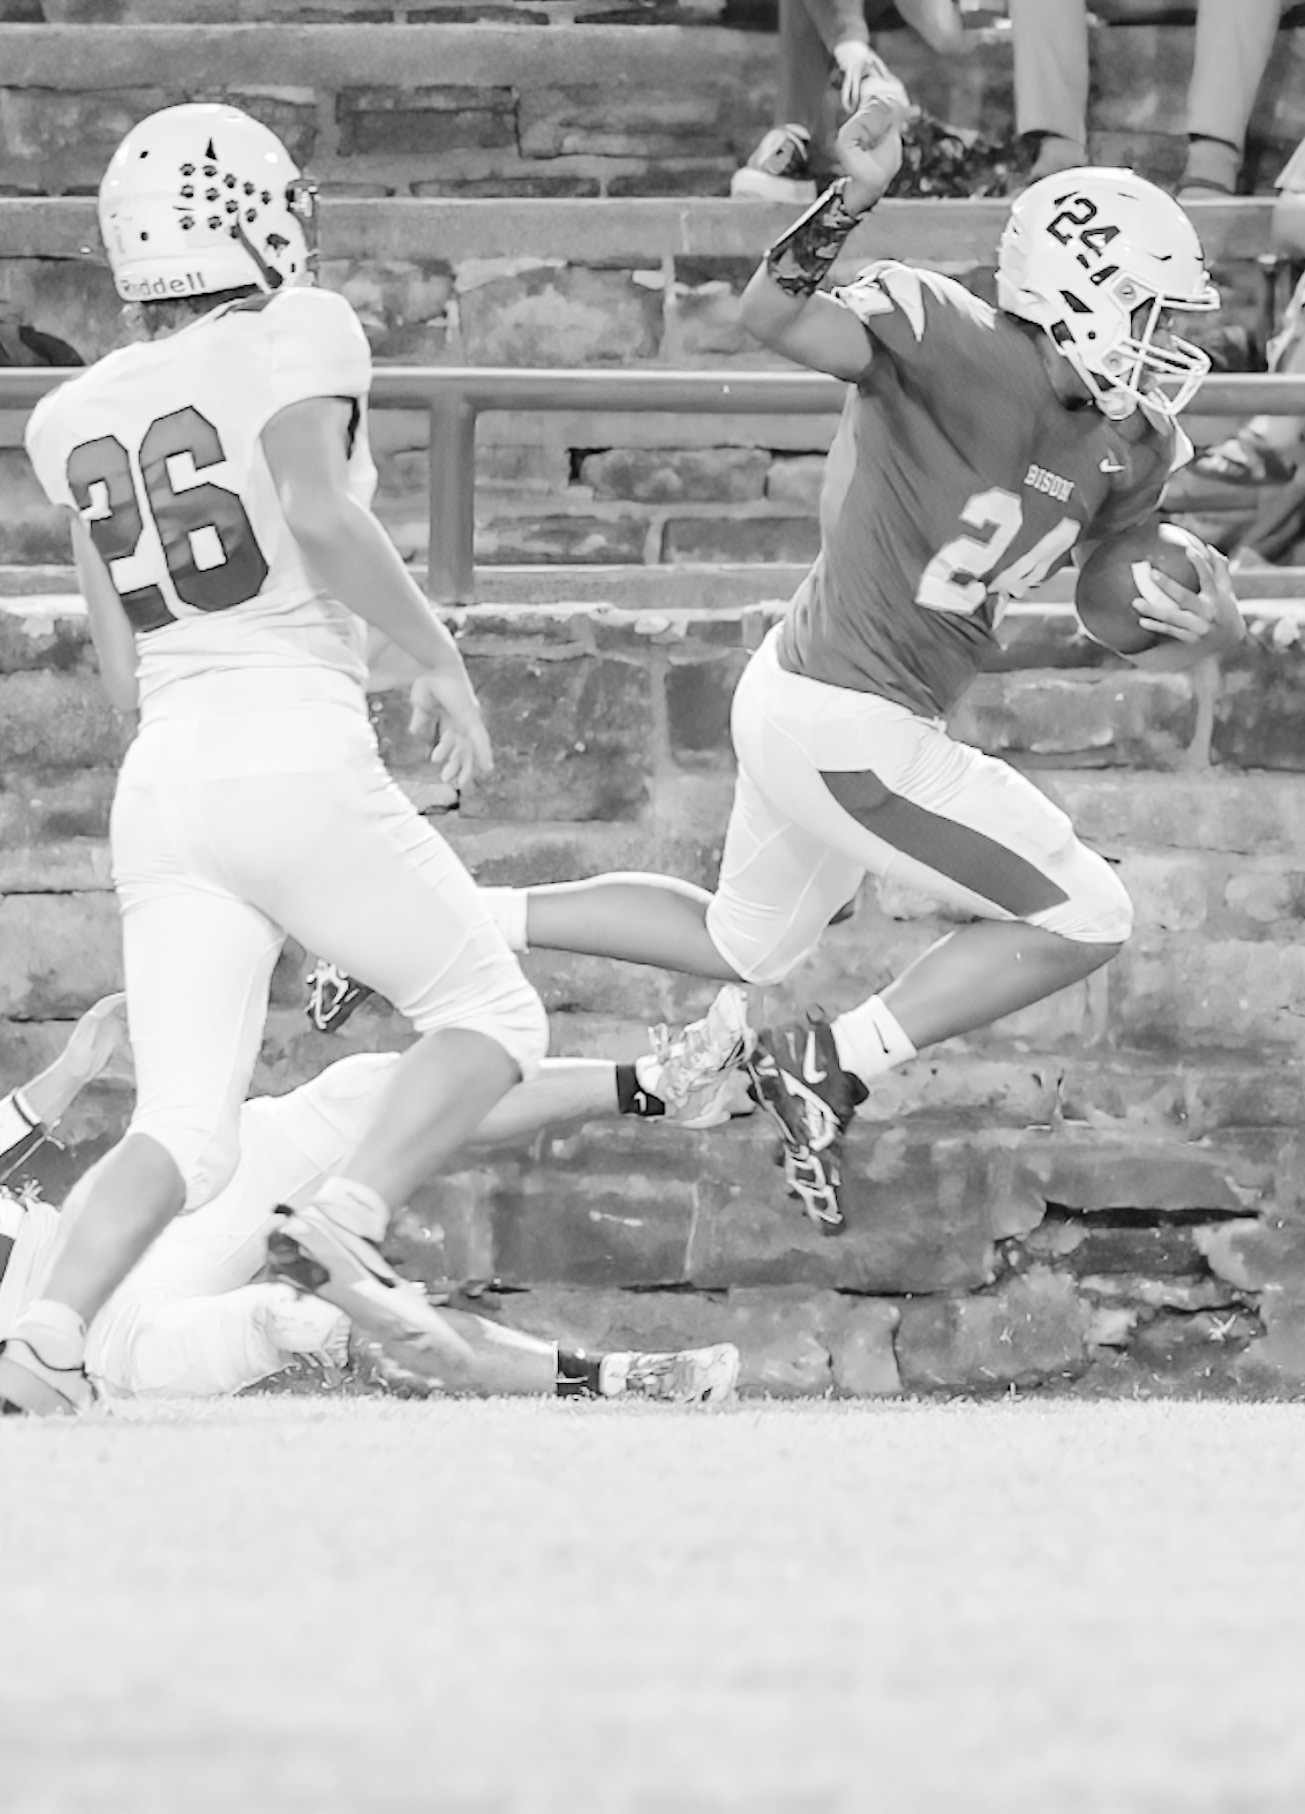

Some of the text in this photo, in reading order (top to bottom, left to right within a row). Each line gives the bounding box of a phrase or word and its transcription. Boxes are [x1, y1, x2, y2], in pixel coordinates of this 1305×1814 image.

[1046, 197, 1121, 269] 24
[66, 405, 269, 633] 26
[1023, 464, 1075, 502] BISON
[915, 486, 1081, 630] 24
